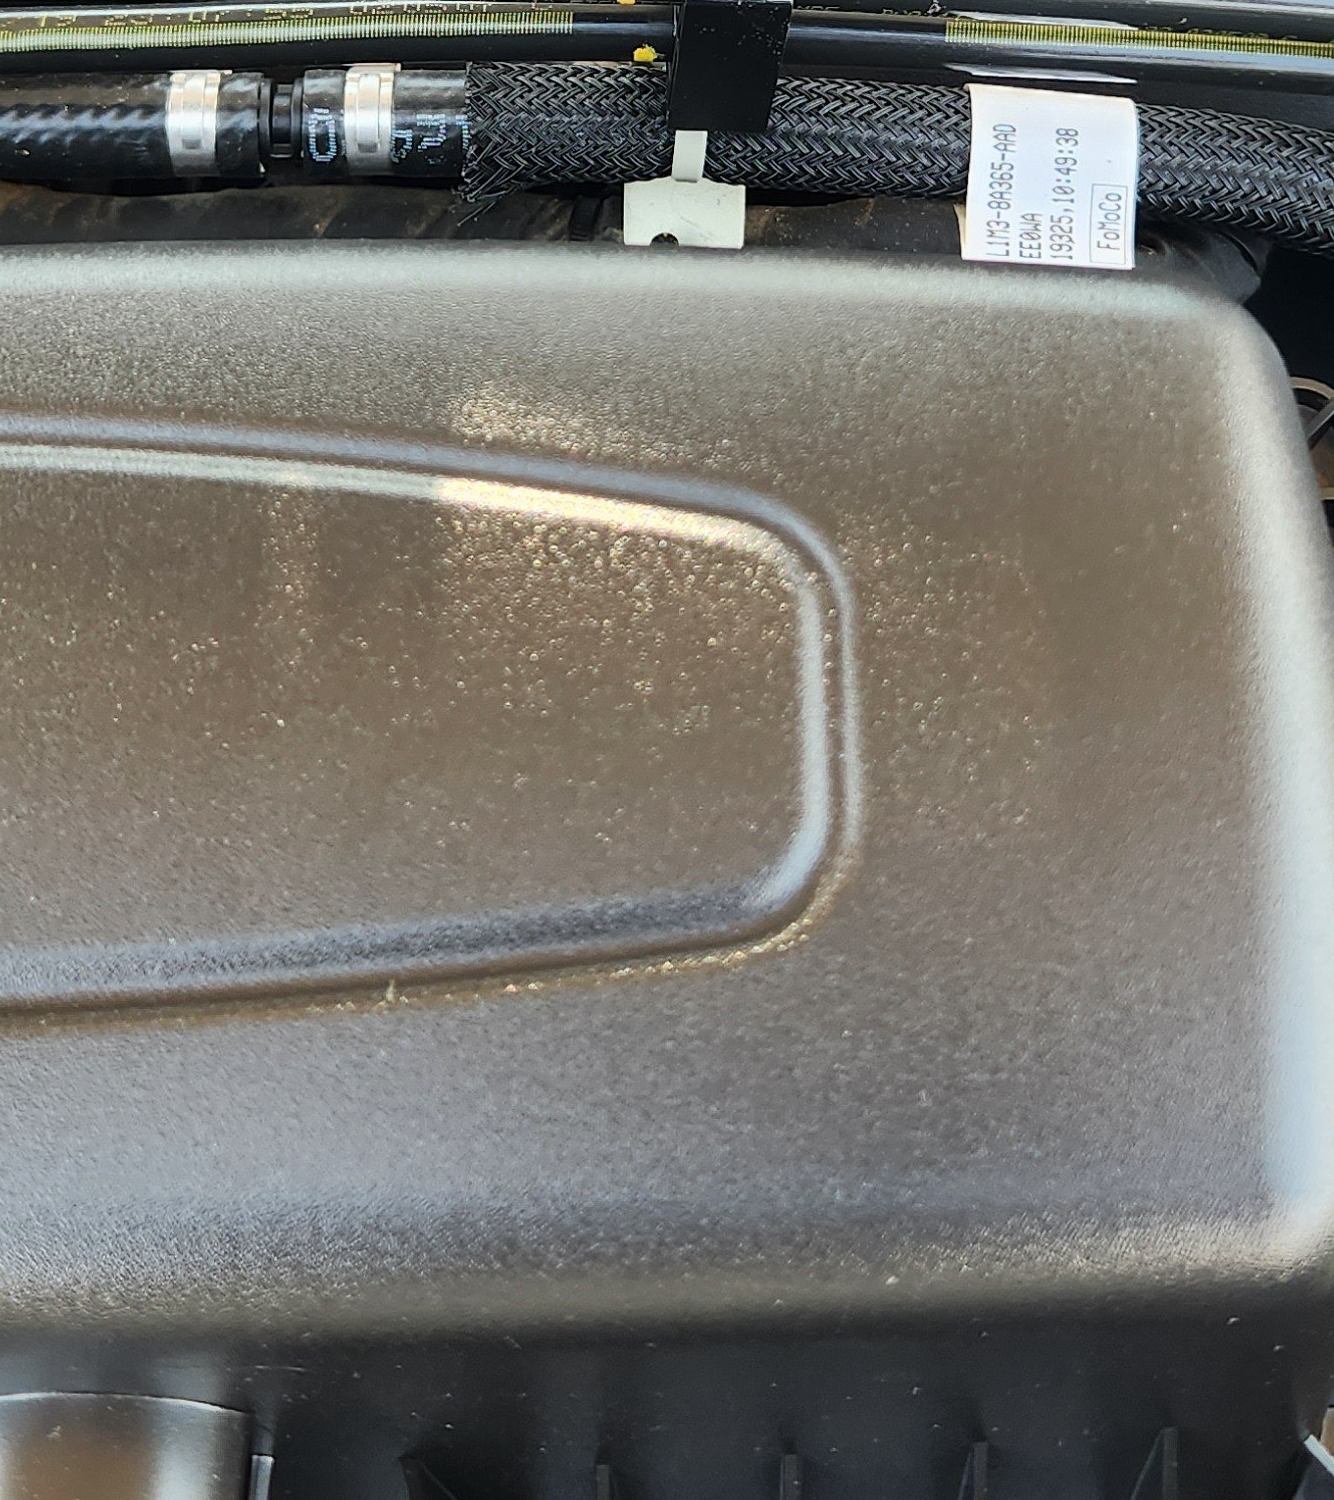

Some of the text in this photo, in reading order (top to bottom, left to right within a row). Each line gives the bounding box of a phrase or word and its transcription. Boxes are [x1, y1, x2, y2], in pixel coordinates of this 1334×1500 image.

[985, 123, 1017, 258] L1M3-8A365-AAD
[1049, 126, 1080, 260] 19325,10:49:38
[1096, 192, 1123, 251] FoMoCo
